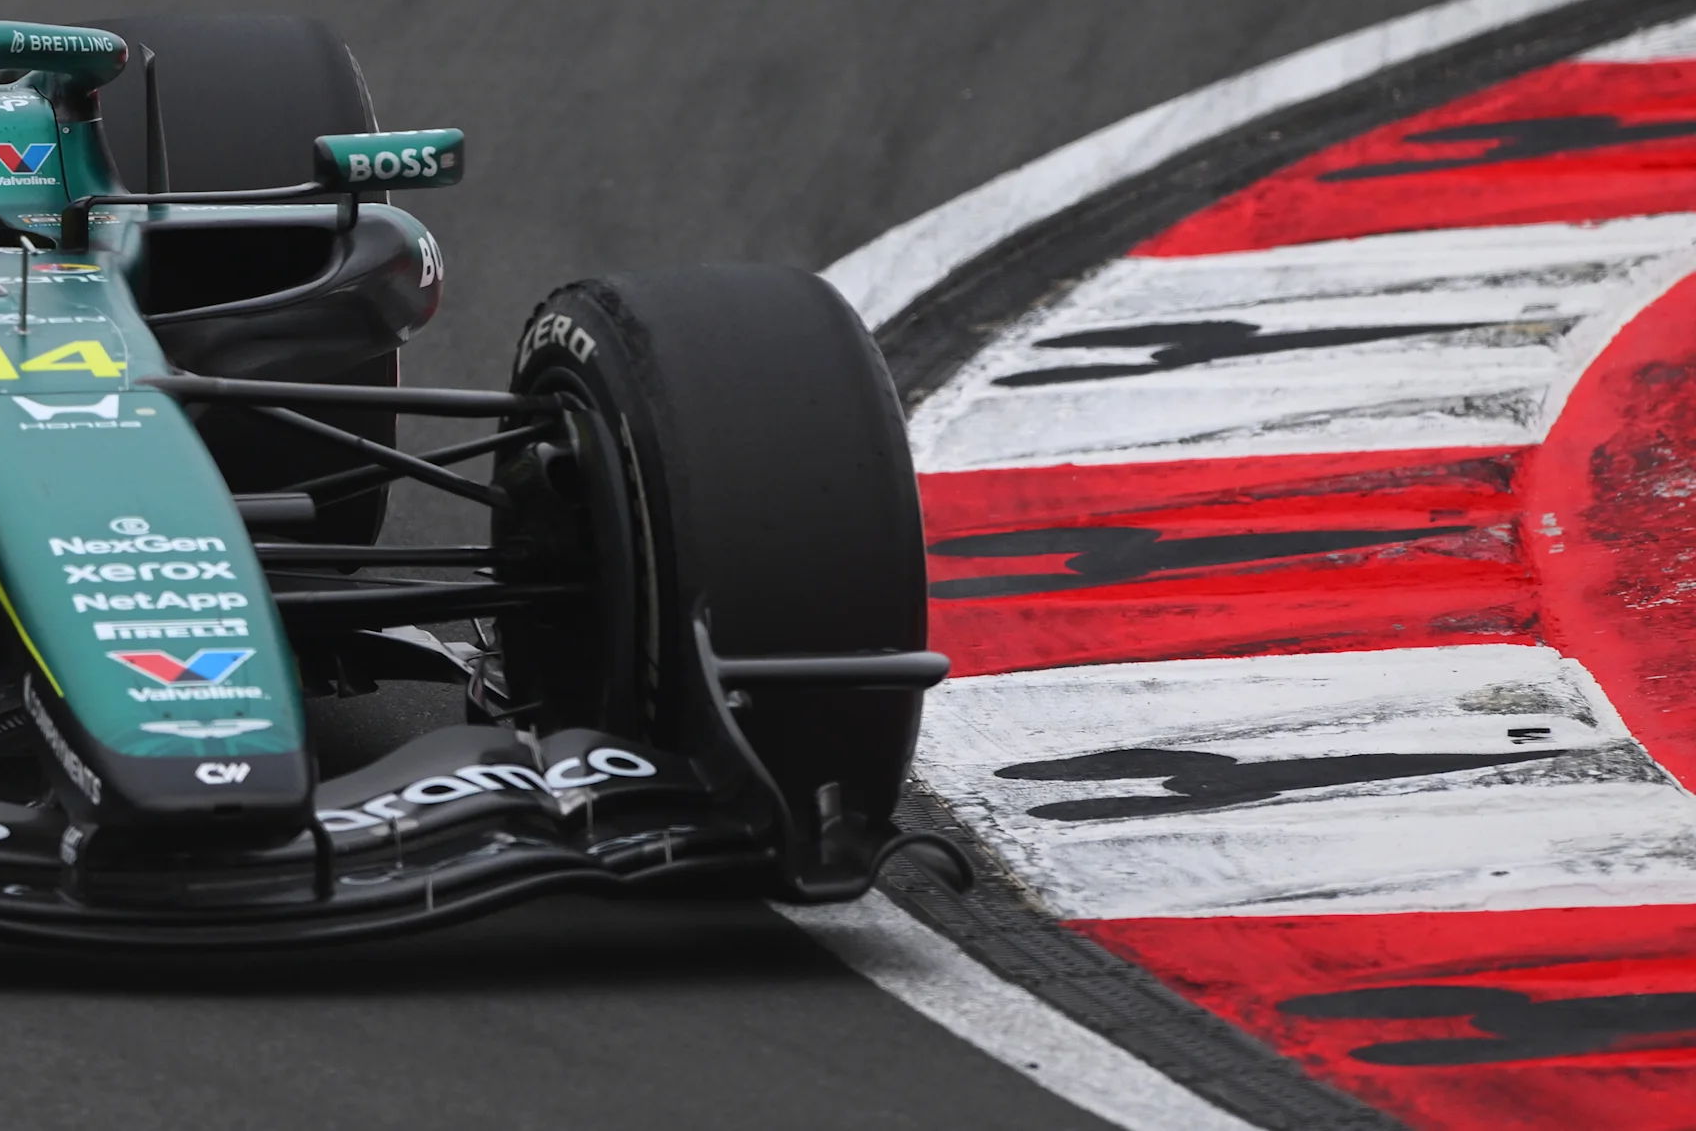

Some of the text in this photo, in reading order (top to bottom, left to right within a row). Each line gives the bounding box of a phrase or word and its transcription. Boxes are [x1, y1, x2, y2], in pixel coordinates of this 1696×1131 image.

[30, 34, 114, 52] BREITLING
[349, 146, 438, 182] BOSS
[19, 420, 143, 430] Honda
[49, 535, 227, 557] NexGen
[62, 560, 237, 585] xerox
[72, 591, 249, 613] NetApp
[93, 617, 250, 641] PIRELLI
[127, 685, 264, 703] Valvoline
[314, 746, 658, 833] aramco
